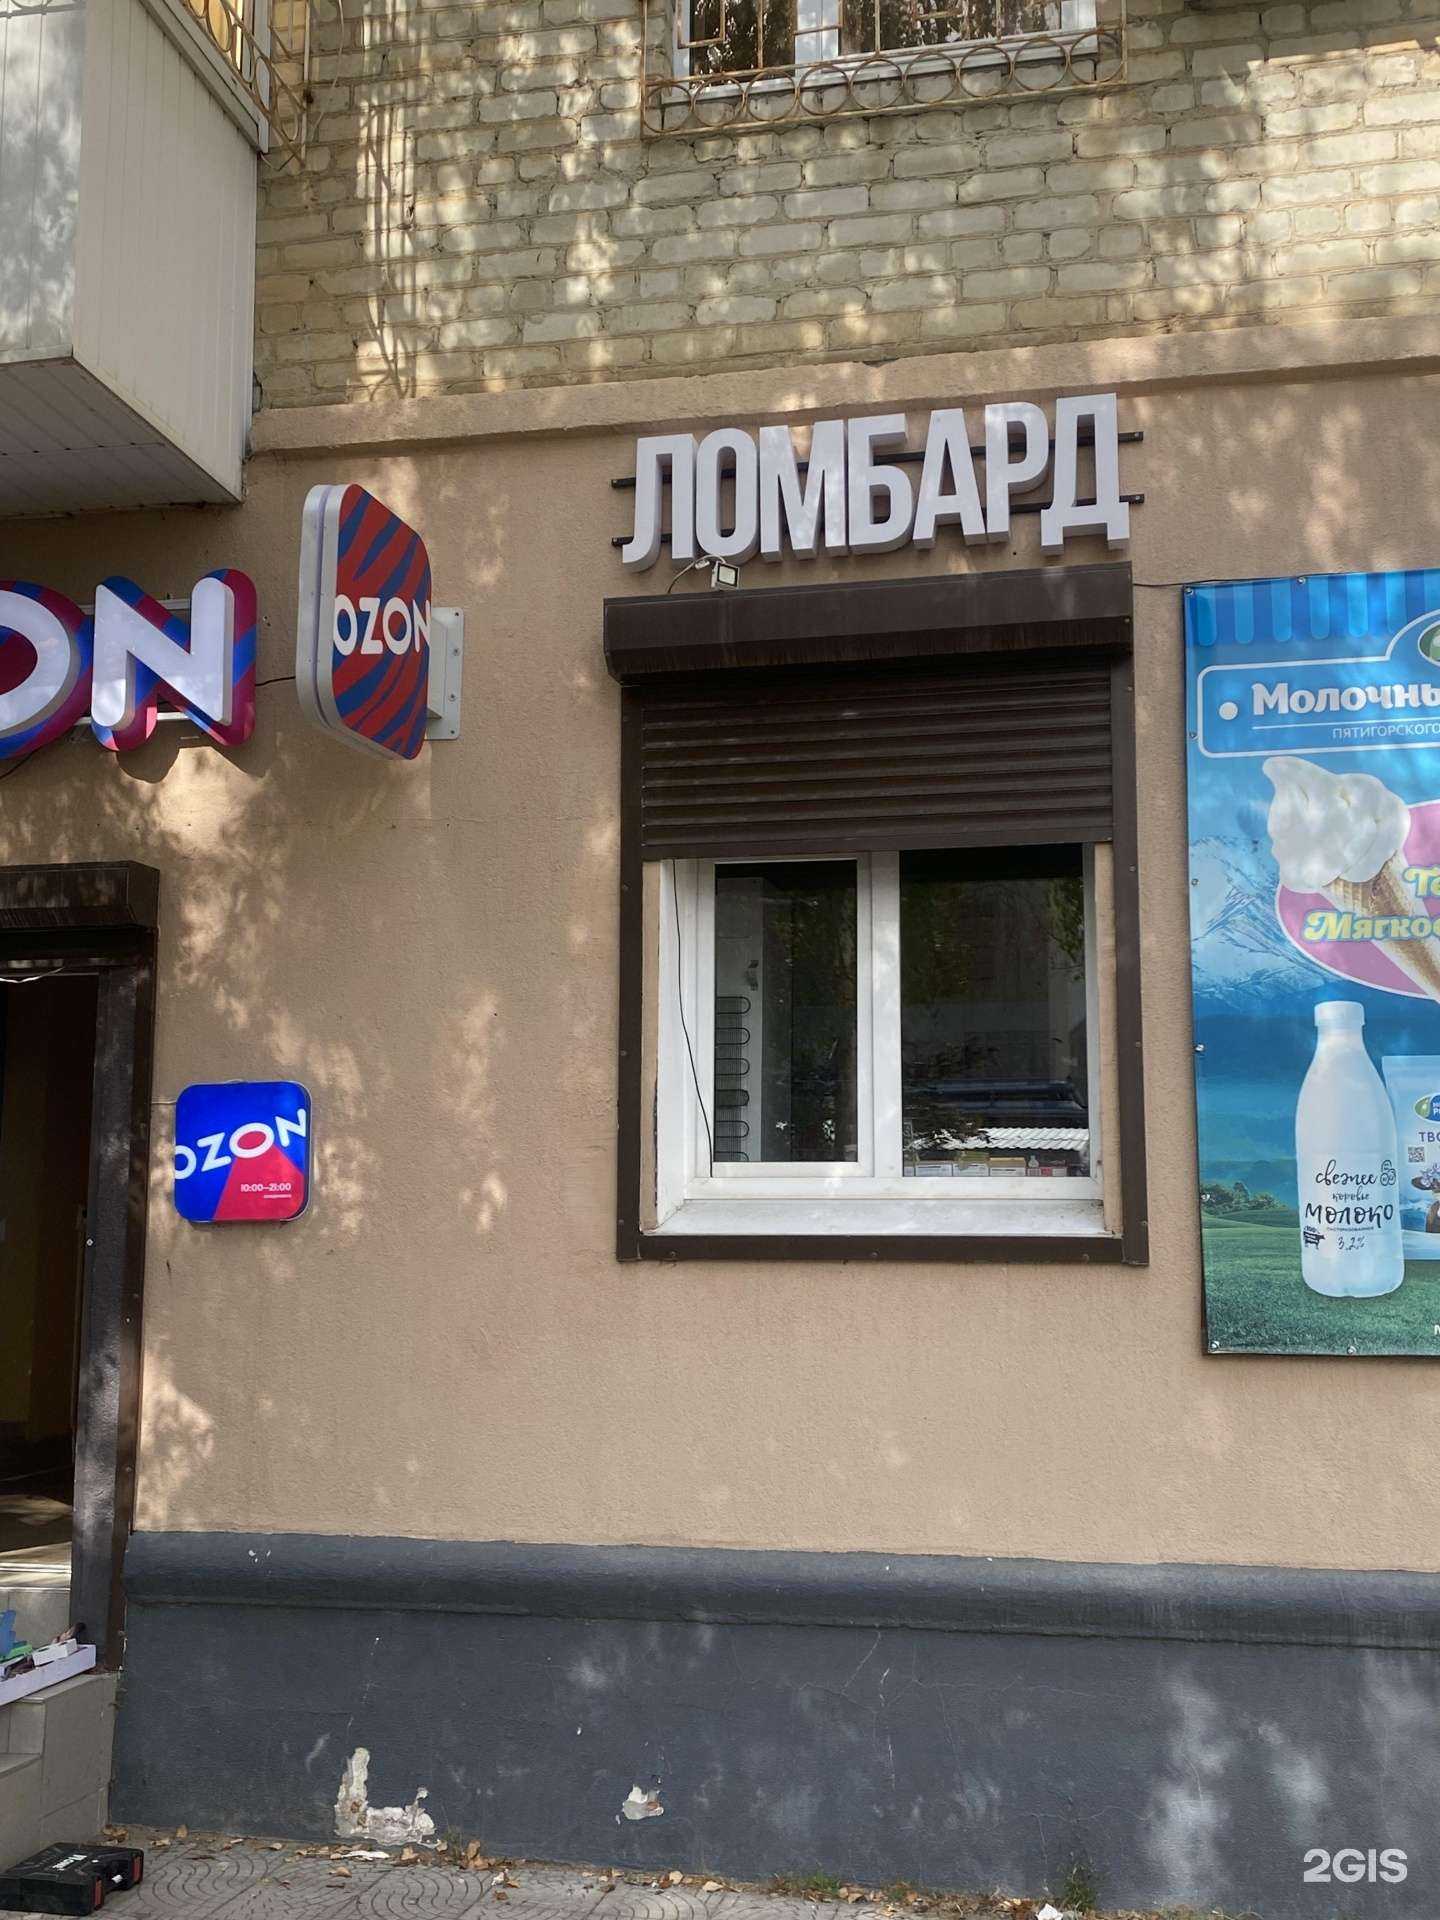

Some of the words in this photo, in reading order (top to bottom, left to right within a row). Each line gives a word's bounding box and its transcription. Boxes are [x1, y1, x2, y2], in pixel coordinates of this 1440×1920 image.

[622, 393, 1130, 571] ЛОМБАРД
[333, 594, 432, 656] OZON
[1332, 722, 1440, 739] ПЯТИГОРСКОГО
[174, 1108, 306, 1180] OZON
